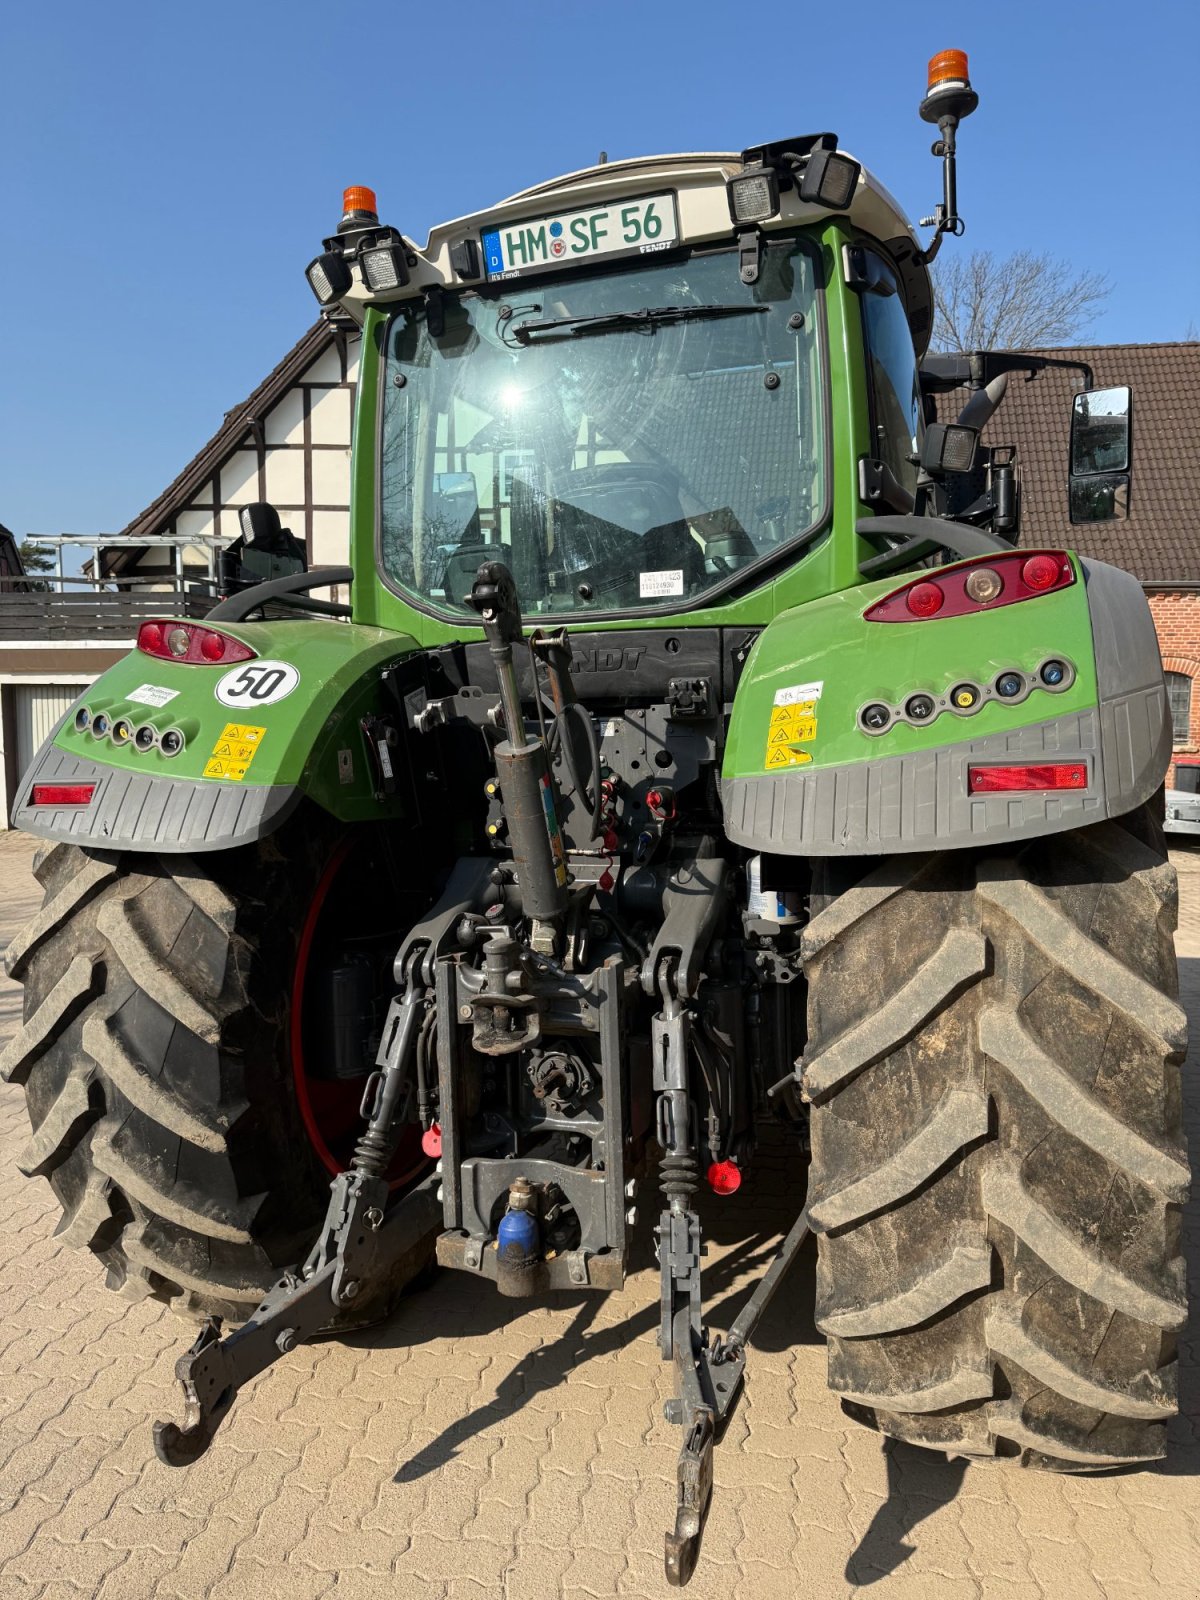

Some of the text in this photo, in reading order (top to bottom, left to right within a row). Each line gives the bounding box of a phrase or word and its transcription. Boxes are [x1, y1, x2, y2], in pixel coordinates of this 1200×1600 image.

[506, 203, 662, 266] HM SF 56
[640, 240, 673, 254] FENDT
[491, 256, 499, 266] D
[568, 646, 647, 673] NDT
[227, 666, 287, 700] 50
